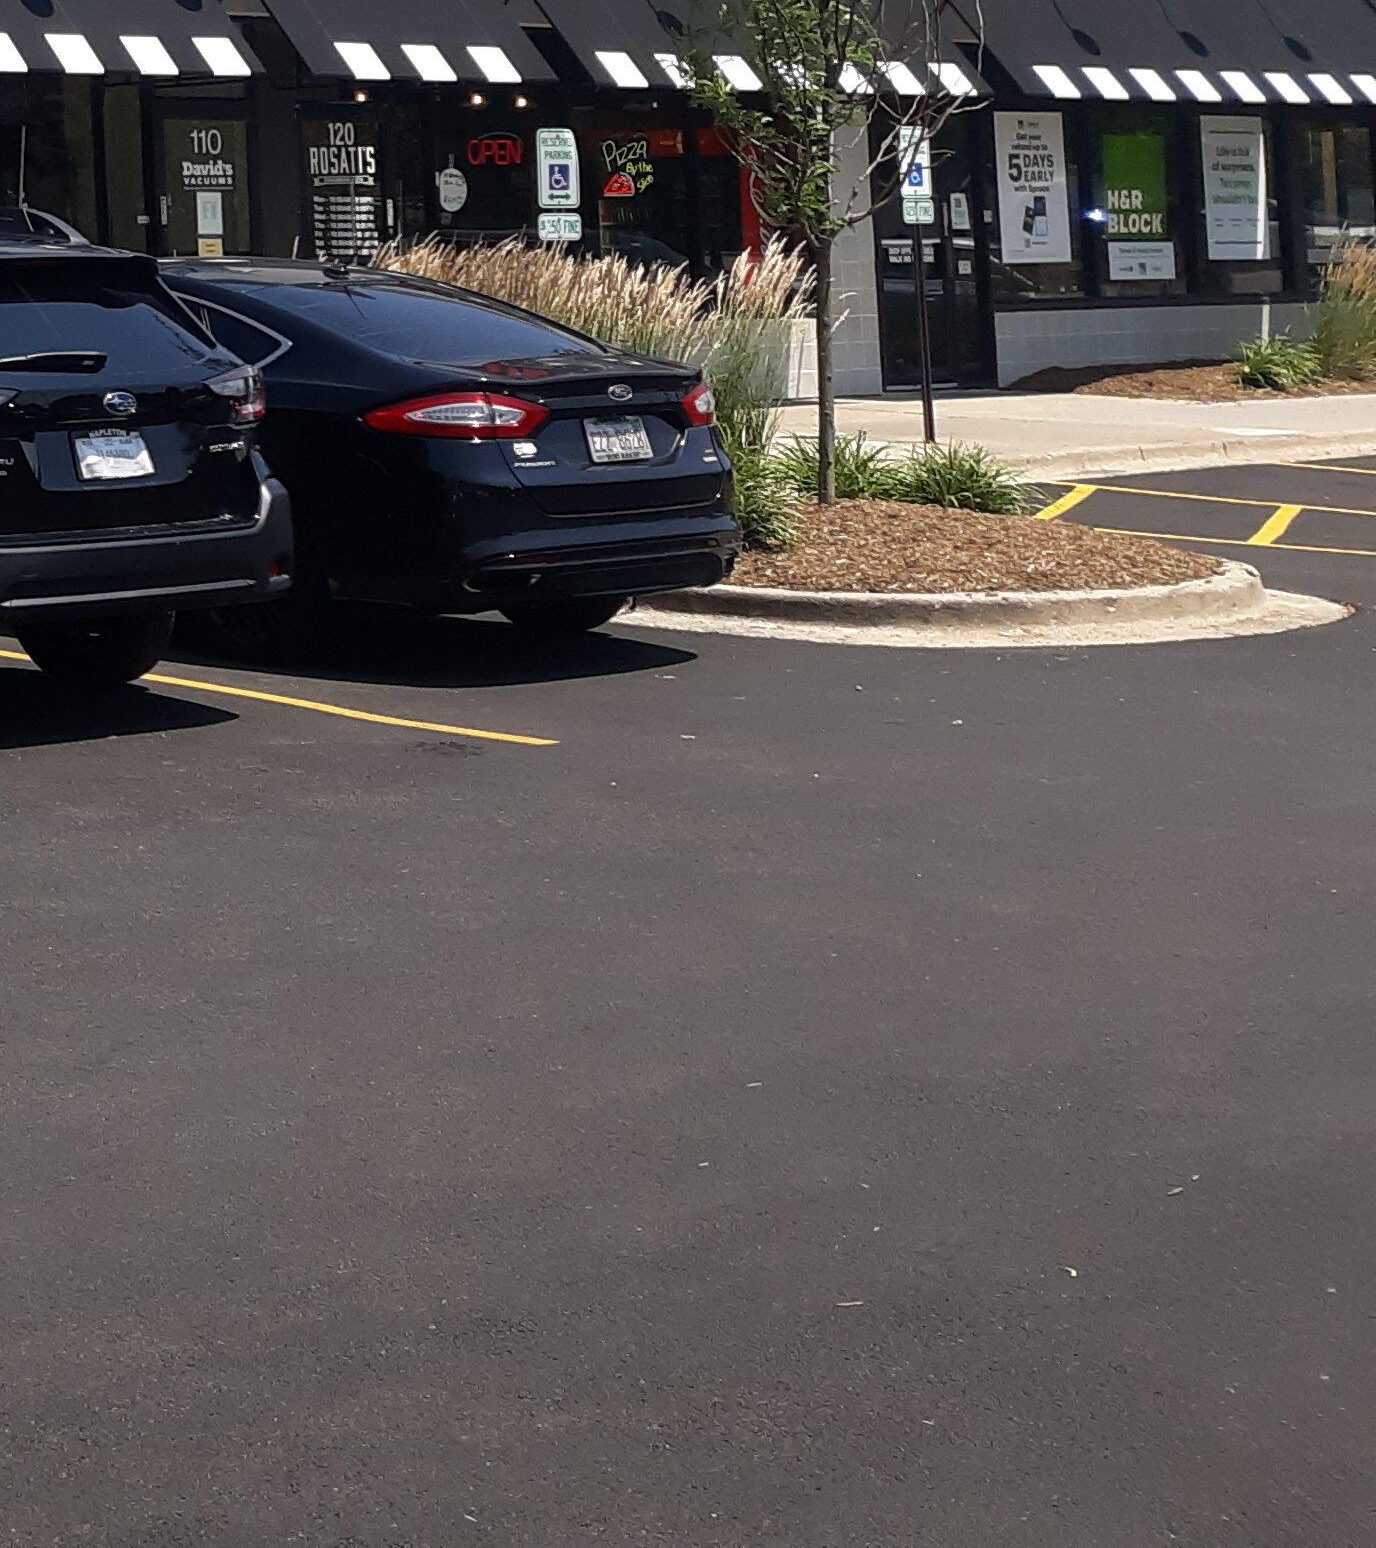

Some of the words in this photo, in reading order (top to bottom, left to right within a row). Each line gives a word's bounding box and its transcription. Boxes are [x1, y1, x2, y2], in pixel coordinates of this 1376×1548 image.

[190, 129, 223, 155] 110
[328, 122, 355, 146] 120
[466, 137, 524, 166] OPEN
[182, 159, 235, 176] David's
[1008, 153, 1023, 182] 5
[1023, 153, 1055, 168] DAYS
[1024, 170, 1055, 183] EARLY
[183, 176, 234, 186] VACUUMS
[1107, 189, 1143, 210] H&R
[1107, 213, 1163, 234] BLOCK
